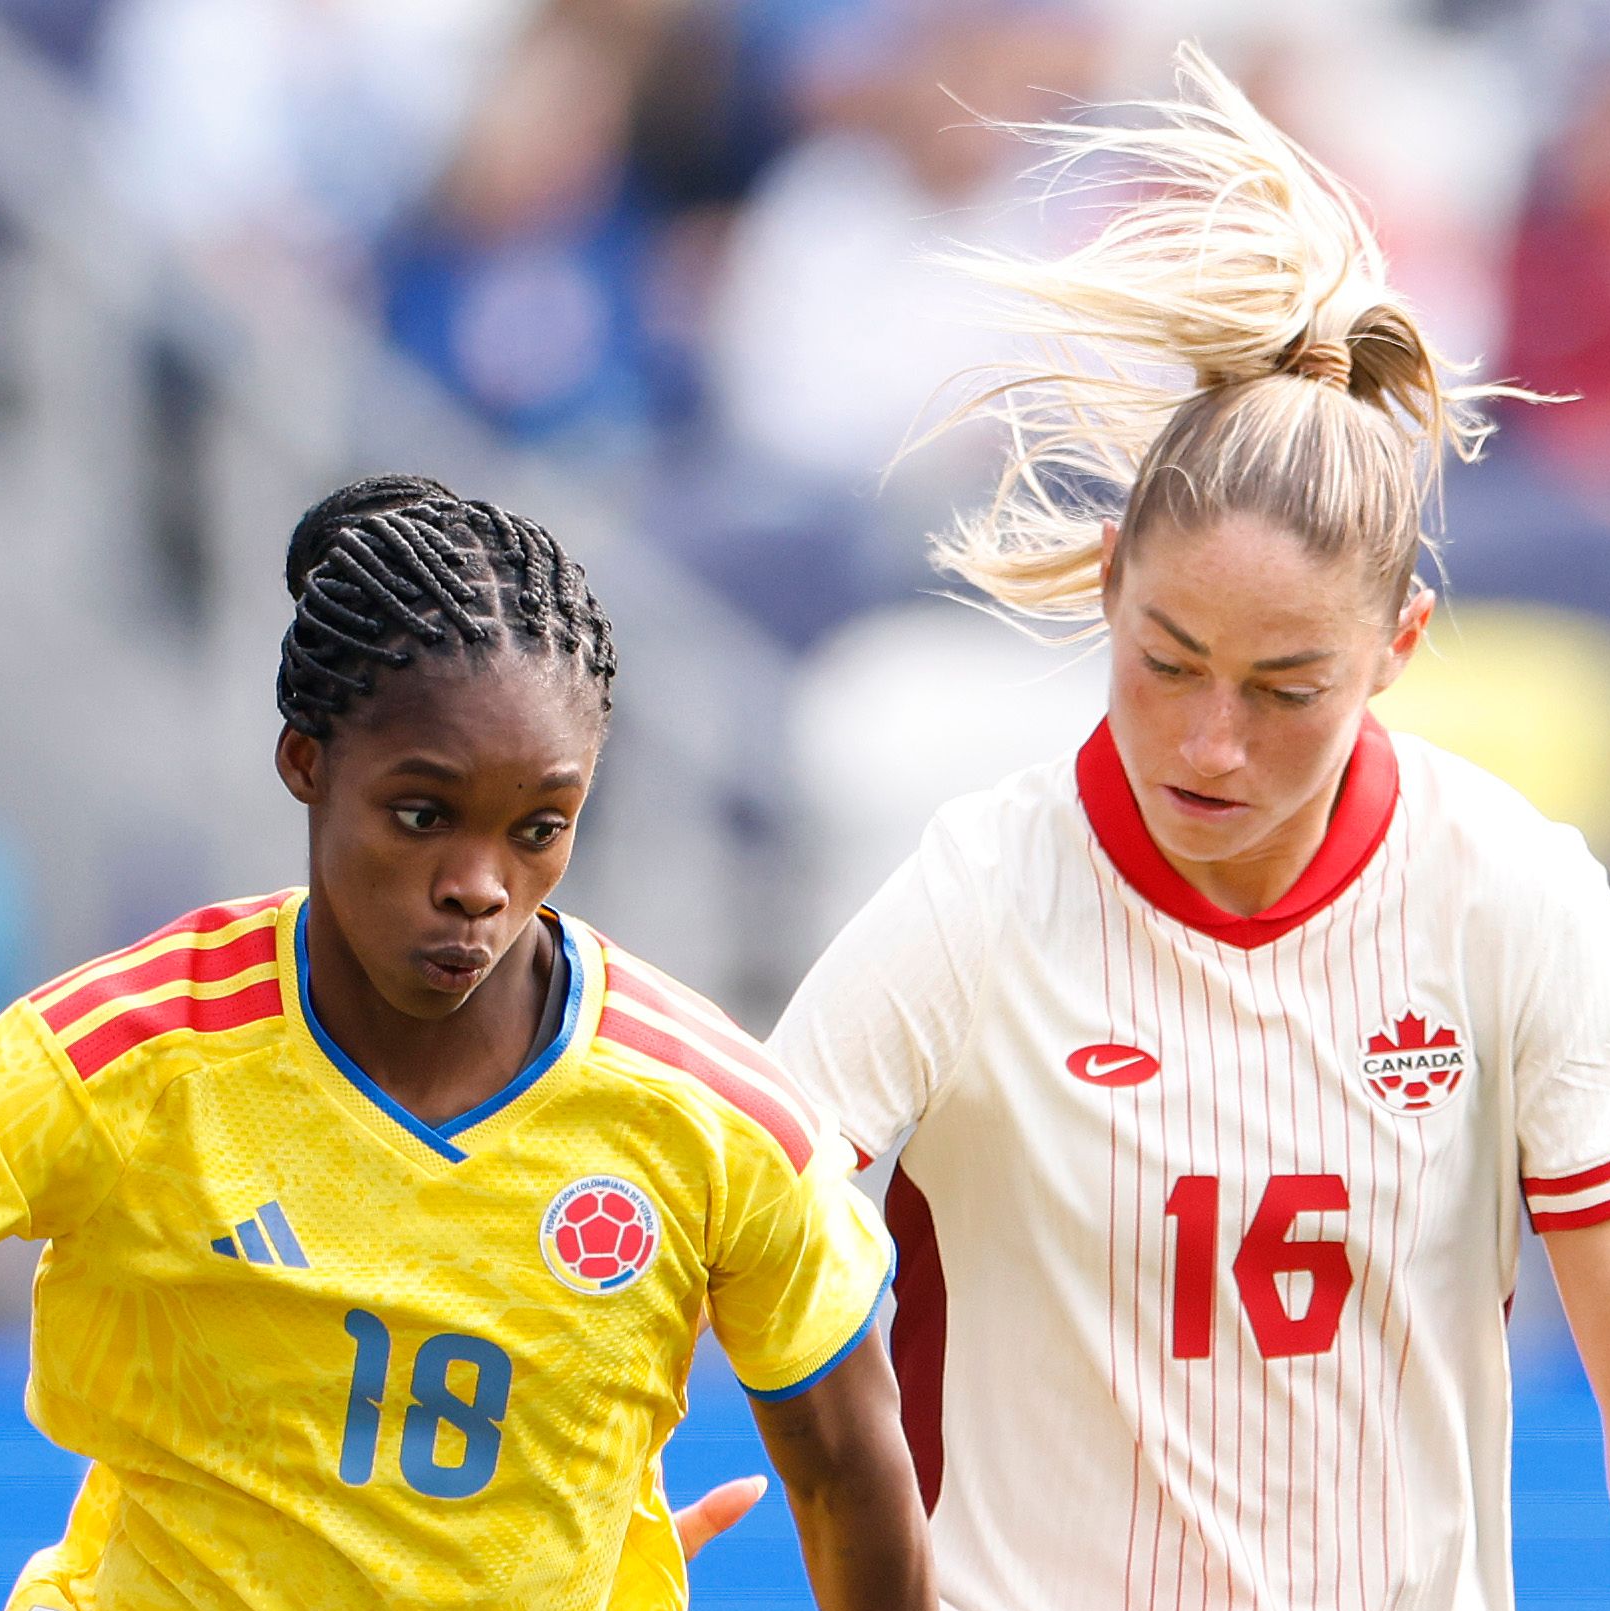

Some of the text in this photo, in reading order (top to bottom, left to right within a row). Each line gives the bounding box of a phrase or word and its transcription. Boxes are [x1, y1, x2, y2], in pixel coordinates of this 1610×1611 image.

[1363, 1052, 1463, 1075] CANADA
[1164, 1174, 1354, 1360] 16
[339, 1308, 513, 1499] 18
